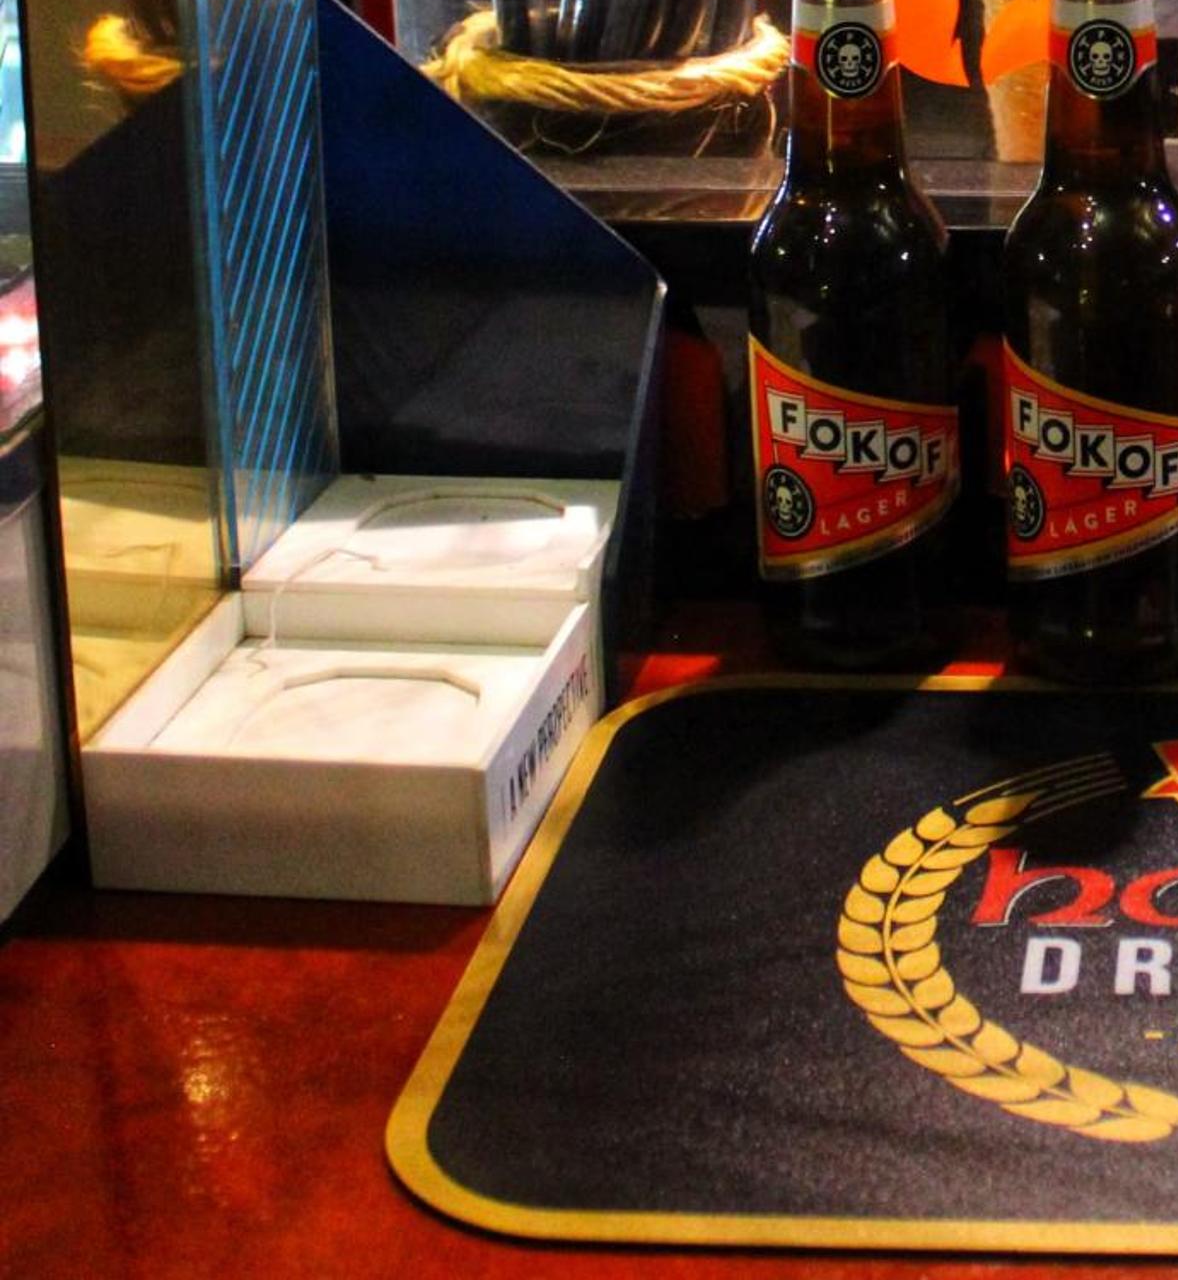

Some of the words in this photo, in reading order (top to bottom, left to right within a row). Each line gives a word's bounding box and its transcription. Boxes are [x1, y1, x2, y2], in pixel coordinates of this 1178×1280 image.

[780, 400, 941, 475] FOKOF
[1018, 398, 1178, 487] FOKOF
[821, 489, 908, 536] LAGER
[1048, 499, 1138, 539] LAGER
